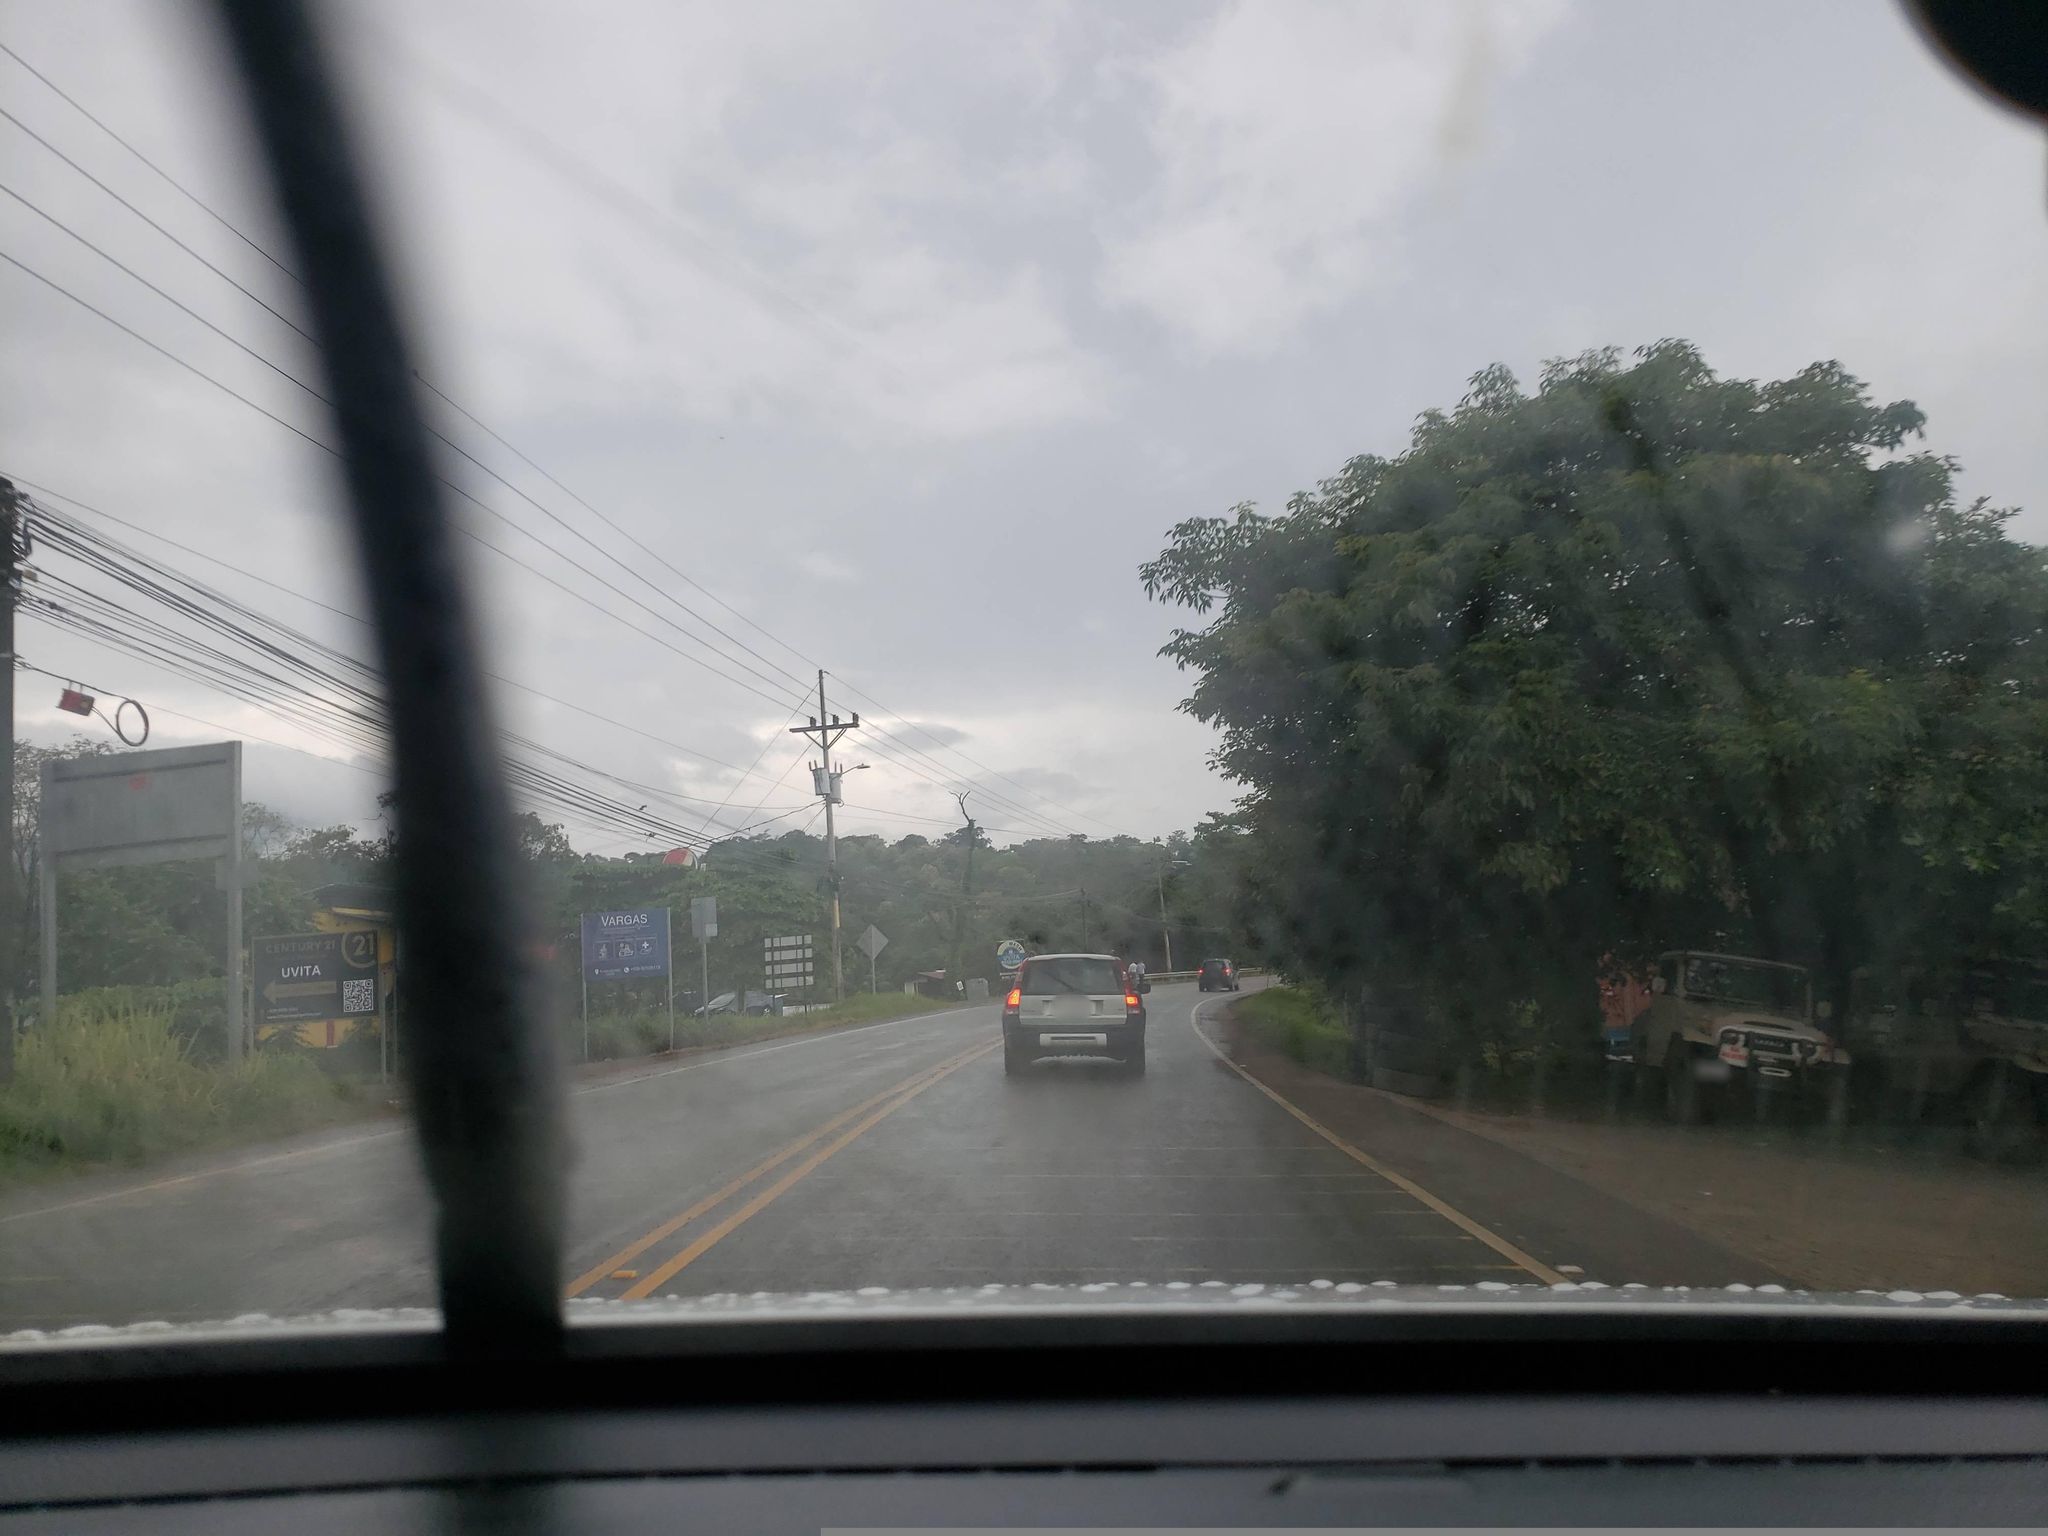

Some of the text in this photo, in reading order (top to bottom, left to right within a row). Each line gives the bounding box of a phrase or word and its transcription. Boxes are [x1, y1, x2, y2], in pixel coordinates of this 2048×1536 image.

[601, 914, 648, 927] VARGAS
[265, 941, 321, 953] CENTURY
[352, 934, 374, 956] 21
[281, 965, 321, 978] UVITA
